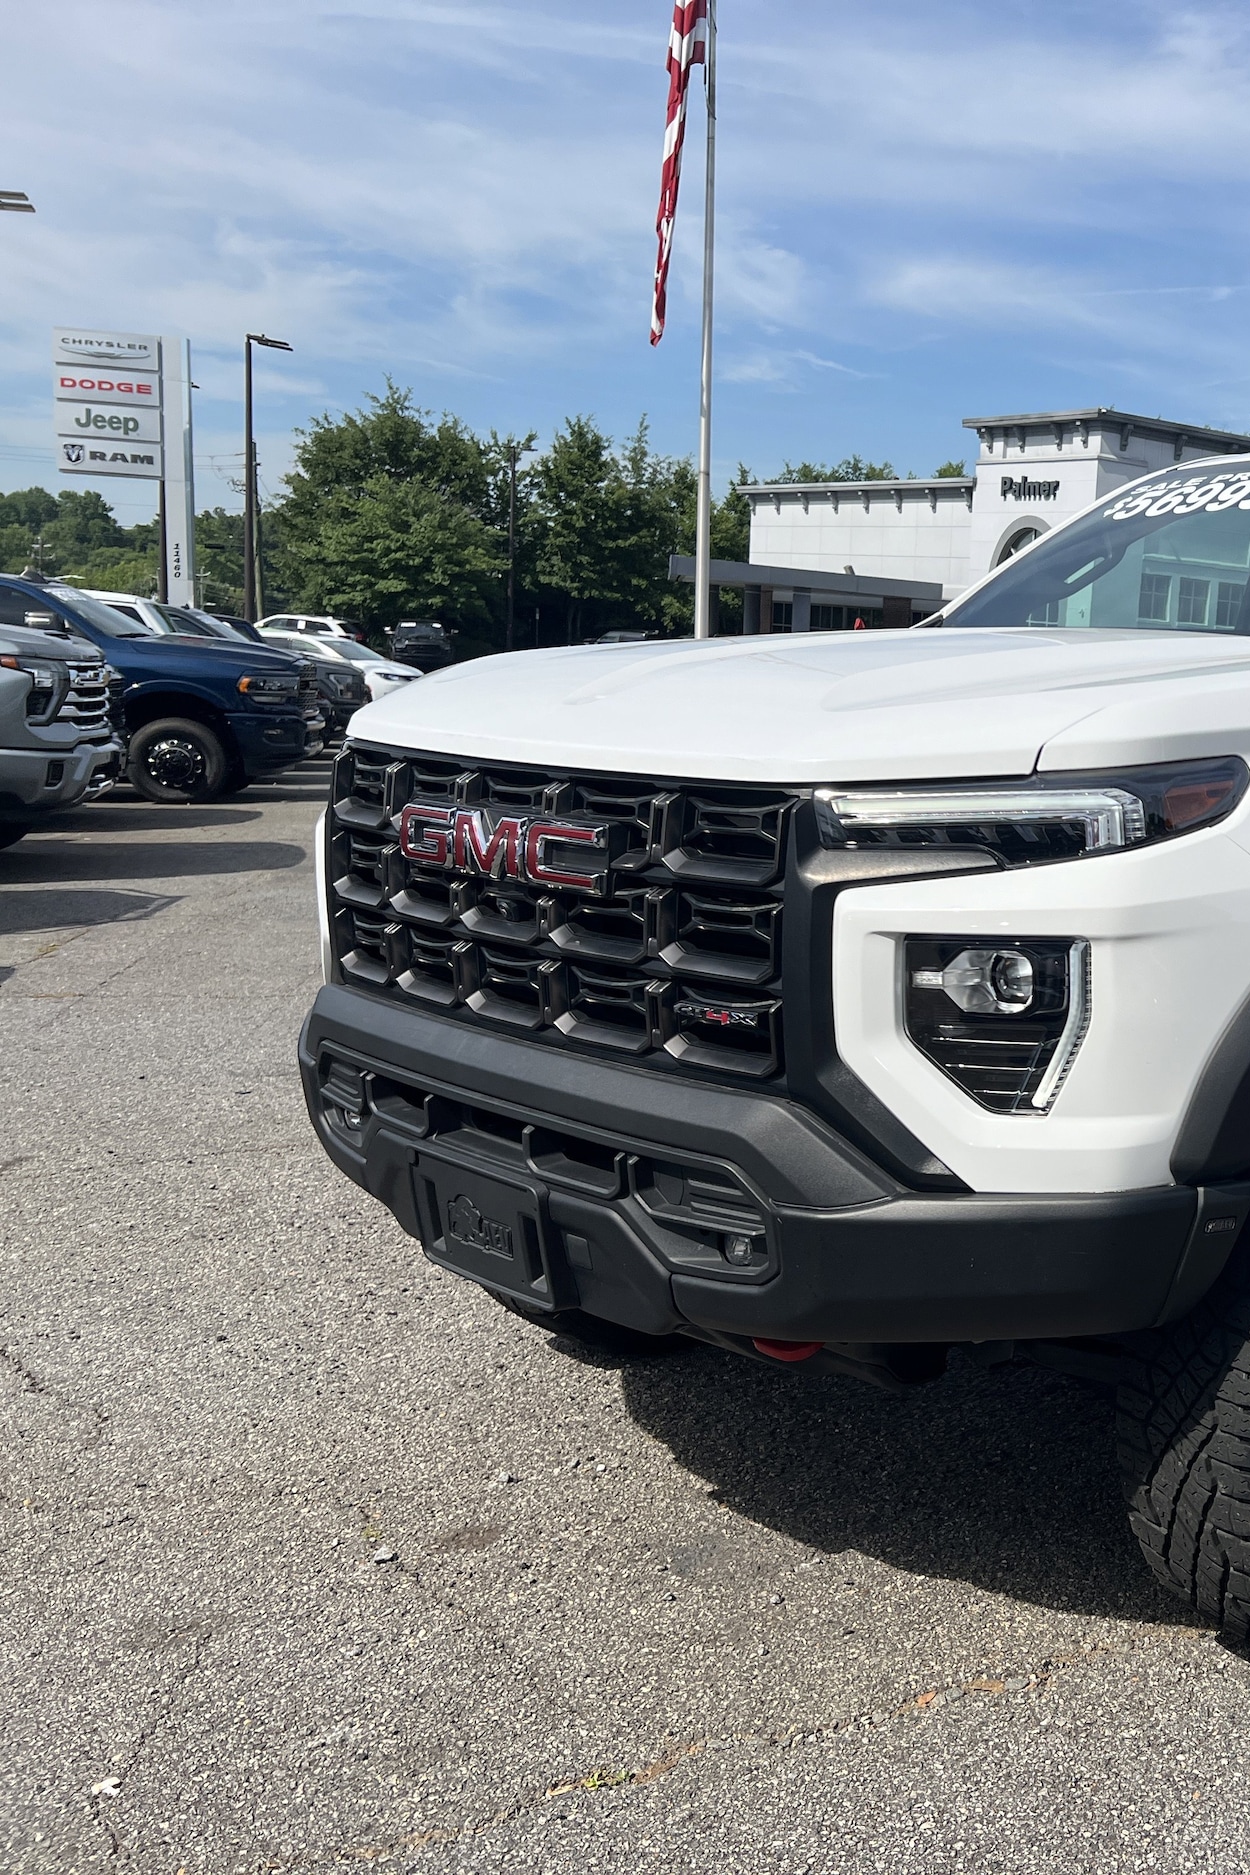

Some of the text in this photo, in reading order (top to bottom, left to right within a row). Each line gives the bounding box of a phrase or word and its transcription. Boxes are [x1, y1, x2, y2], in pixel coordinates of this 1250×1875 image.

[61, 337, 148, 351] CHRYSLER
[60, 377, 152, 395] DODGE
[74, 408, 139, 436] Jeep
[89, 451, 154, 465] RAM
[1000, 475, 1060, 501] Palmer
[1131, 476, 1208, 494] SALE
[173, 543, 181, 578] 11460
[401, 802, 608, 896] GMC
